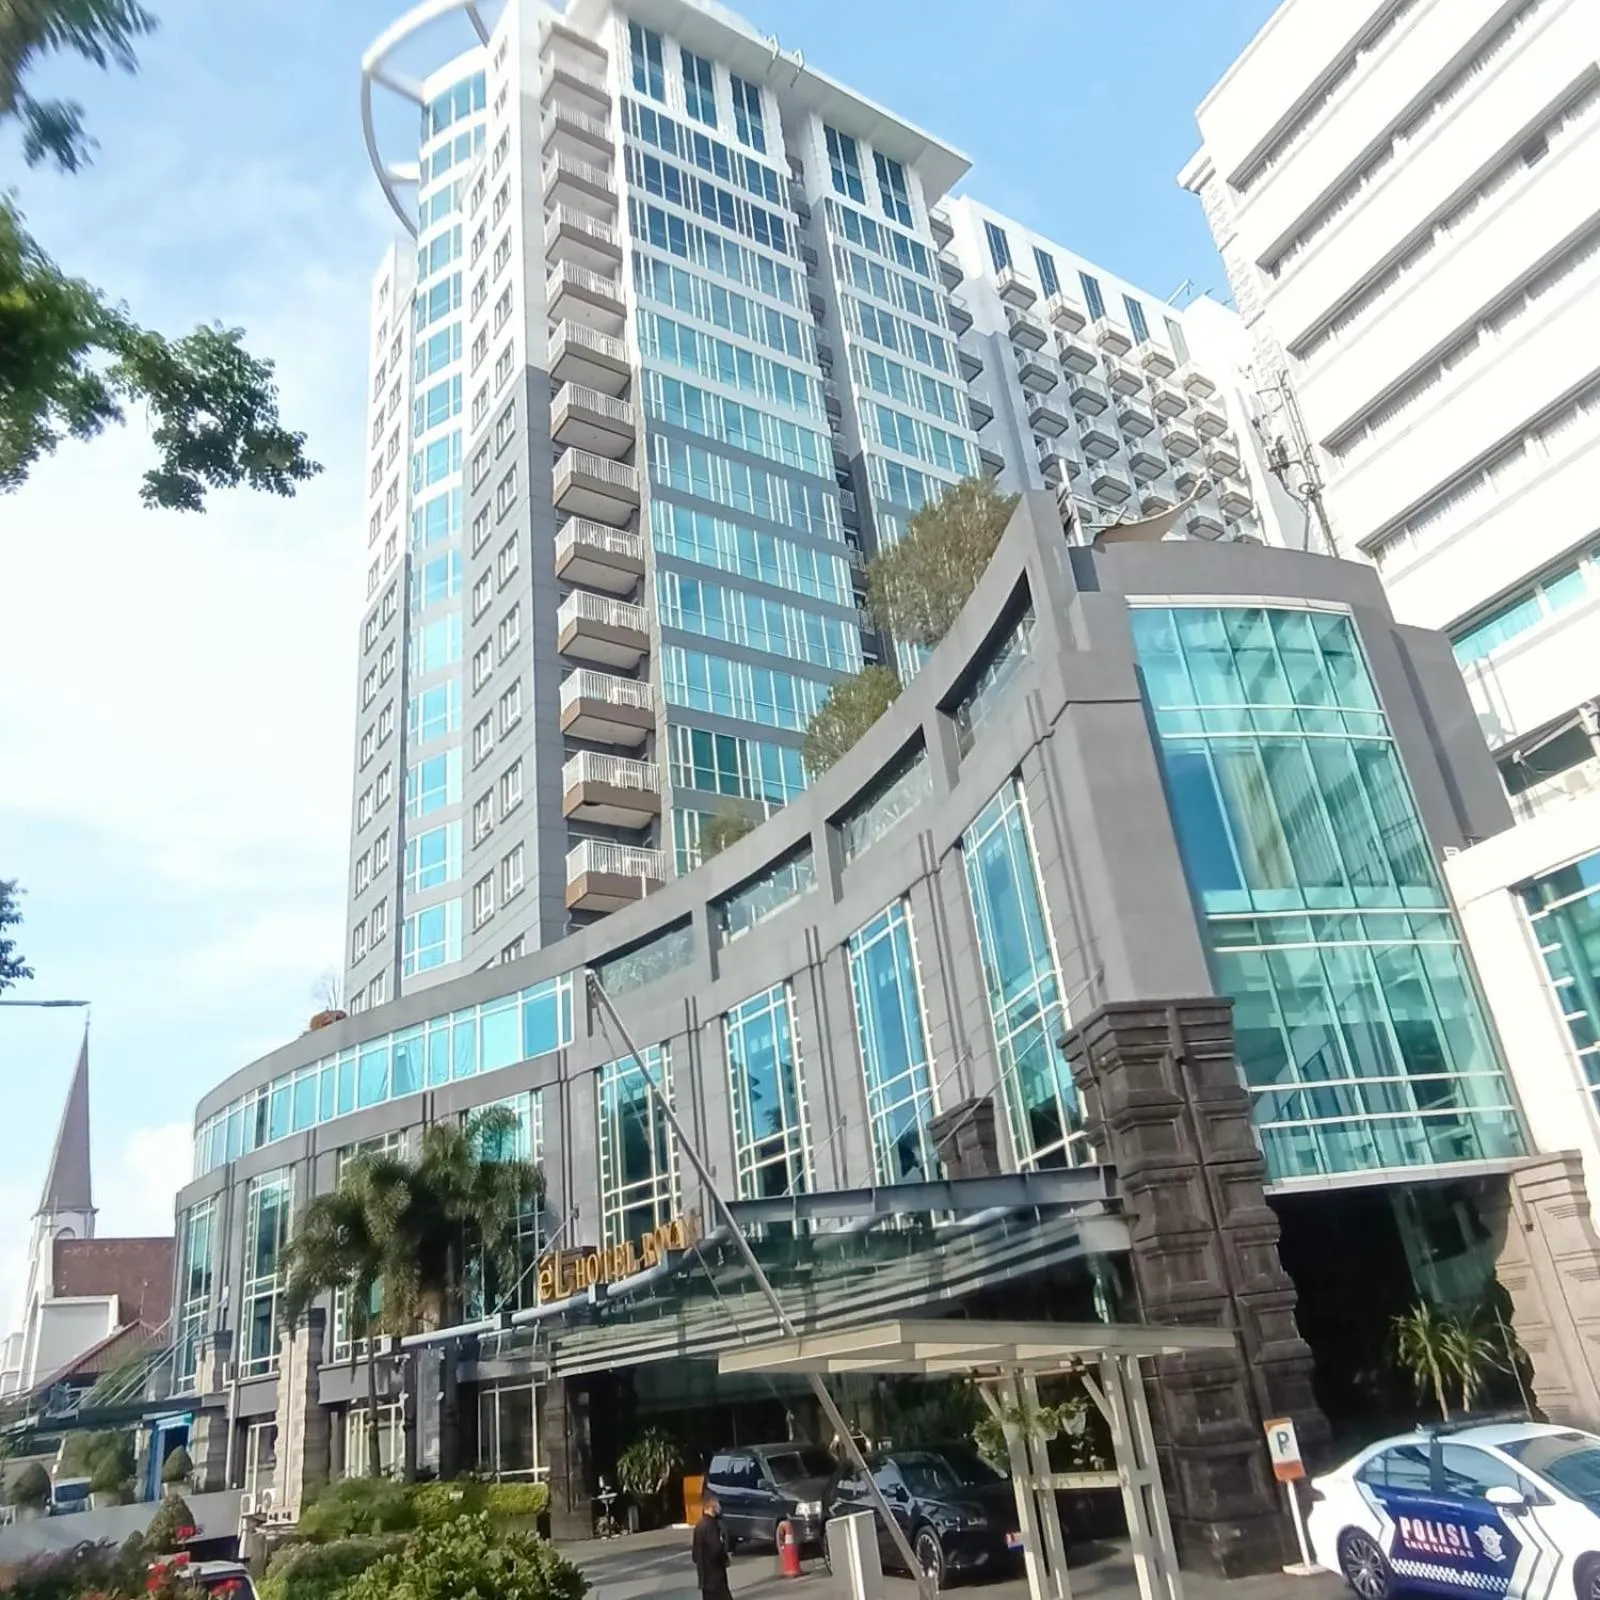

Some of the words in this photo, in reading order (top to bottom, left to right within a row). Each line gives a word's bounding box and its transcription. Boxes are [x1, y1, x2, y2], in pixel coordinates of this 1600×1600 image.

[575, 1241, 637, 1290] HOTEL
[1276, 1431, 1289, 1455] P
[1399, 1516, 1471, 1549] POLISI
